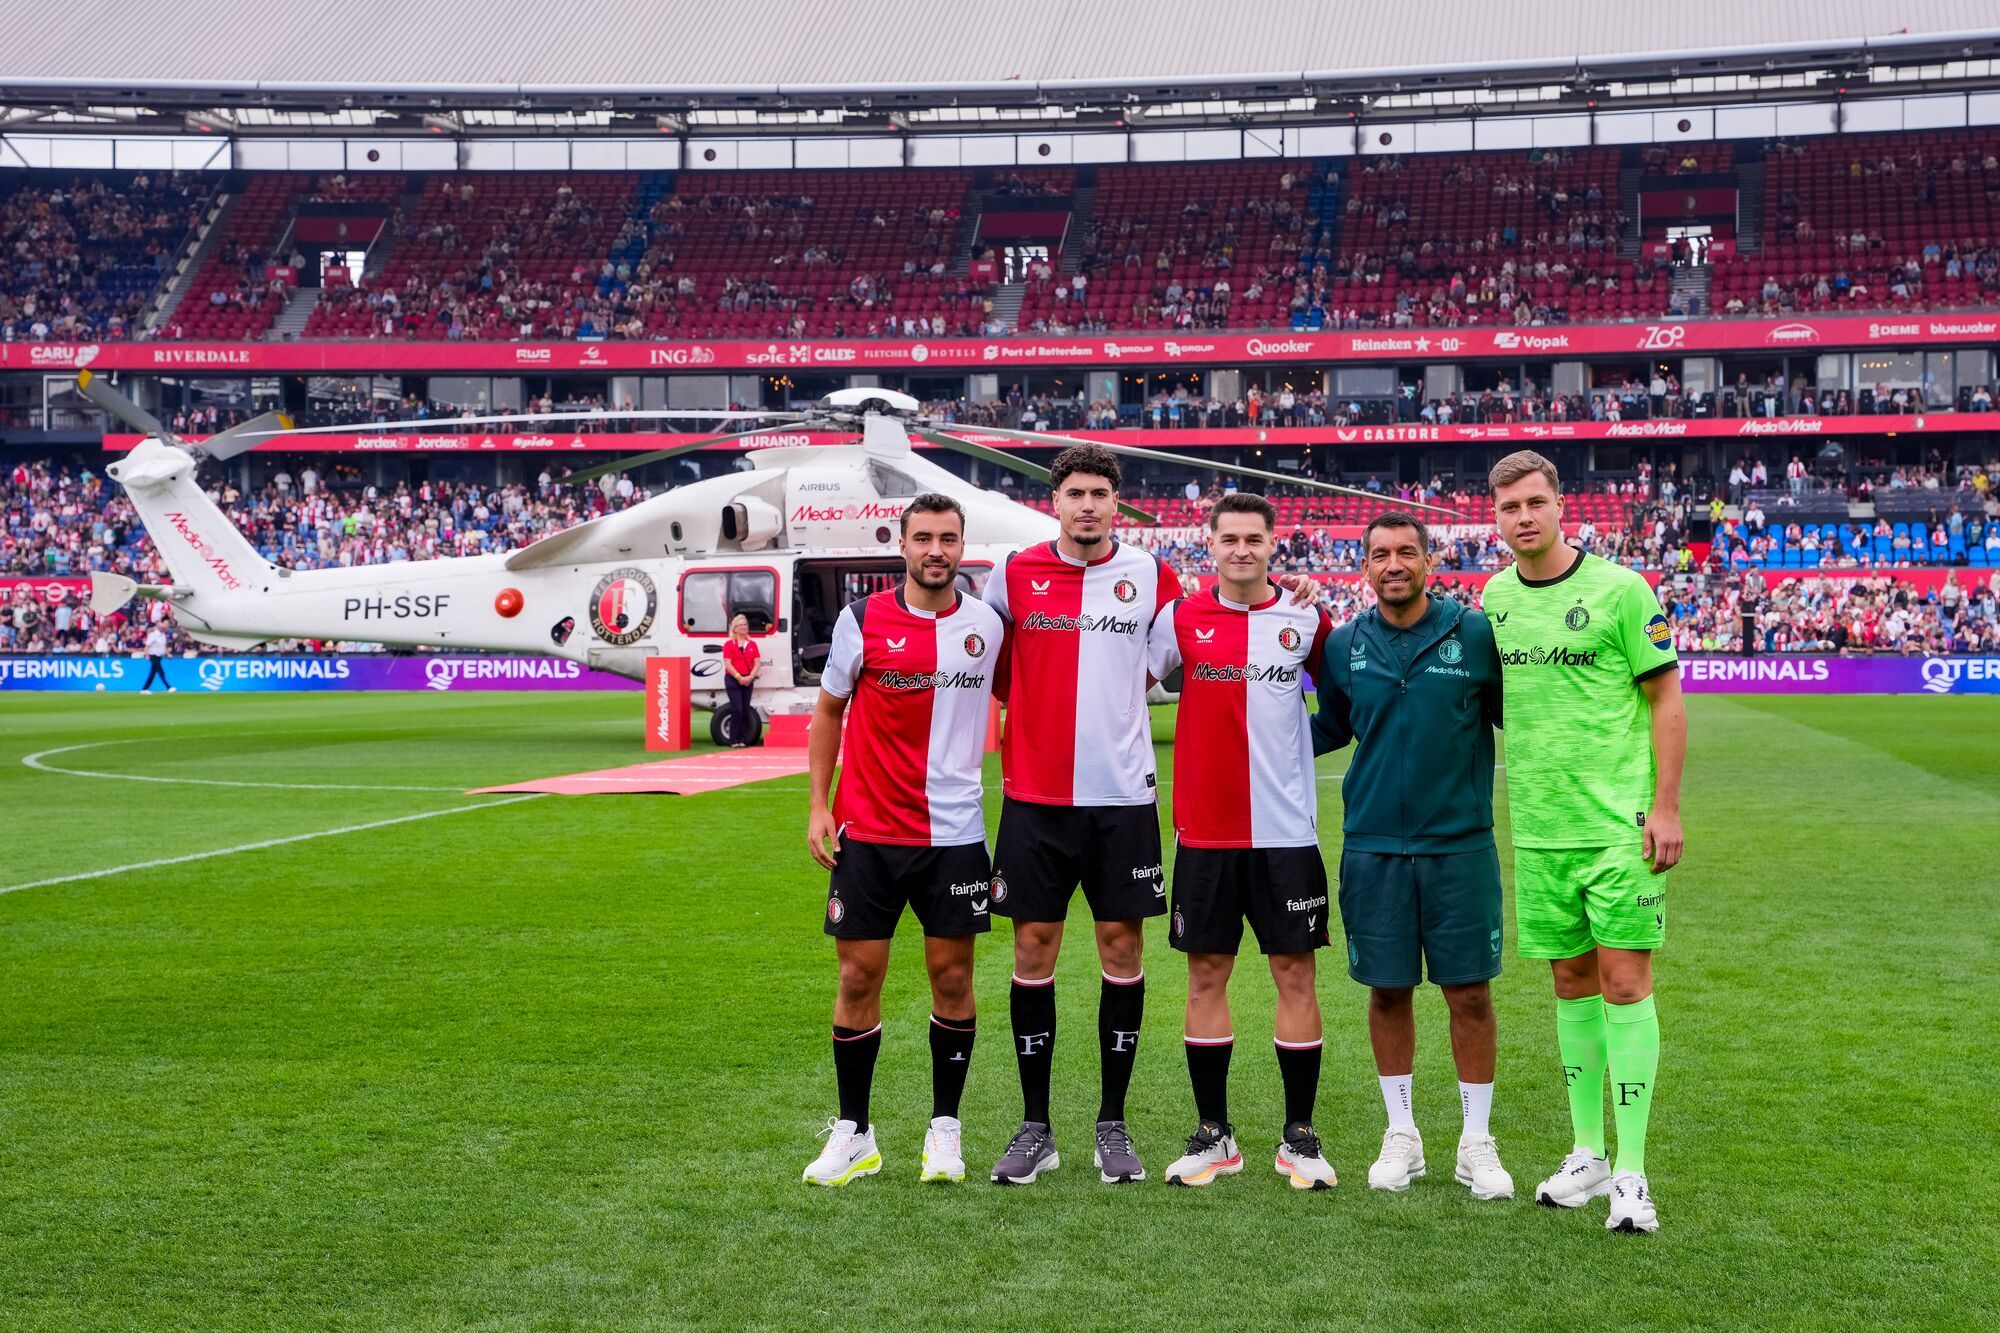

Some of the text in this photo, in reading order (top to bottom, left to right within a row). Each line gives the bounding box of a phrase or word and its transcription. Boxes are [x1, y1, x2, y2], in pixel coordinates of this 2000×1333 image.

[1881, 324, 1920, 336] DEME
[1930, 322, 1997, 335] bluewater
[1002, 345, 1093, 358] Port of Rotterdam
[1120, 345, 1154, 353] GROUP
[1181, 344, 1215, 352] GROUP
[1246, 338, 1312, 356] Quooker
[1352, 338, 1412, 351] Heineken
[1523, 335, 1569, 350] Vopak
[31, 347, 74, 359] CARU
[154, 351, 250, 363] RIVERDALE
[651, 350, 688, 365] ING
[864, 348, 977, 359] FLETCHER HOTELS
[354, 437, 396, 449] Jordex
[415, 437, 457, 449] Jordex
[739, 435, 810, 448] BURANDO
[1363, 427, 1439, 441] CASTORE
[798, 482, 841, 492] AIRBUS
[790, 503, 844, 522] Media
[593, 568, 655, 597] FEYENOORD
[344, 595, 450, 620] PH-SSF
[591, 614, 653, 645] ROTTERDAM
[1023, 612, 1138, 636] Media Markt
[1545, 646, 1597, 666] Markt
[0, 660, 125, 680] TERMINALS
[199, 658, 349, 690] QTERMINALS
[425, 658, 580, 690] QTERMINALS
[1192, 663, 1242, 682] Media
[877, 671, 985, 689] Media Markt
[1286, 895, 1327, 913] fairphone
[1019, 1031, 1050, 1055] F
[1110, 1030, 1139, 1052] F
[1563, 1065, 1583, 1087] F
[1617, 1082, 1646, 1106] F
